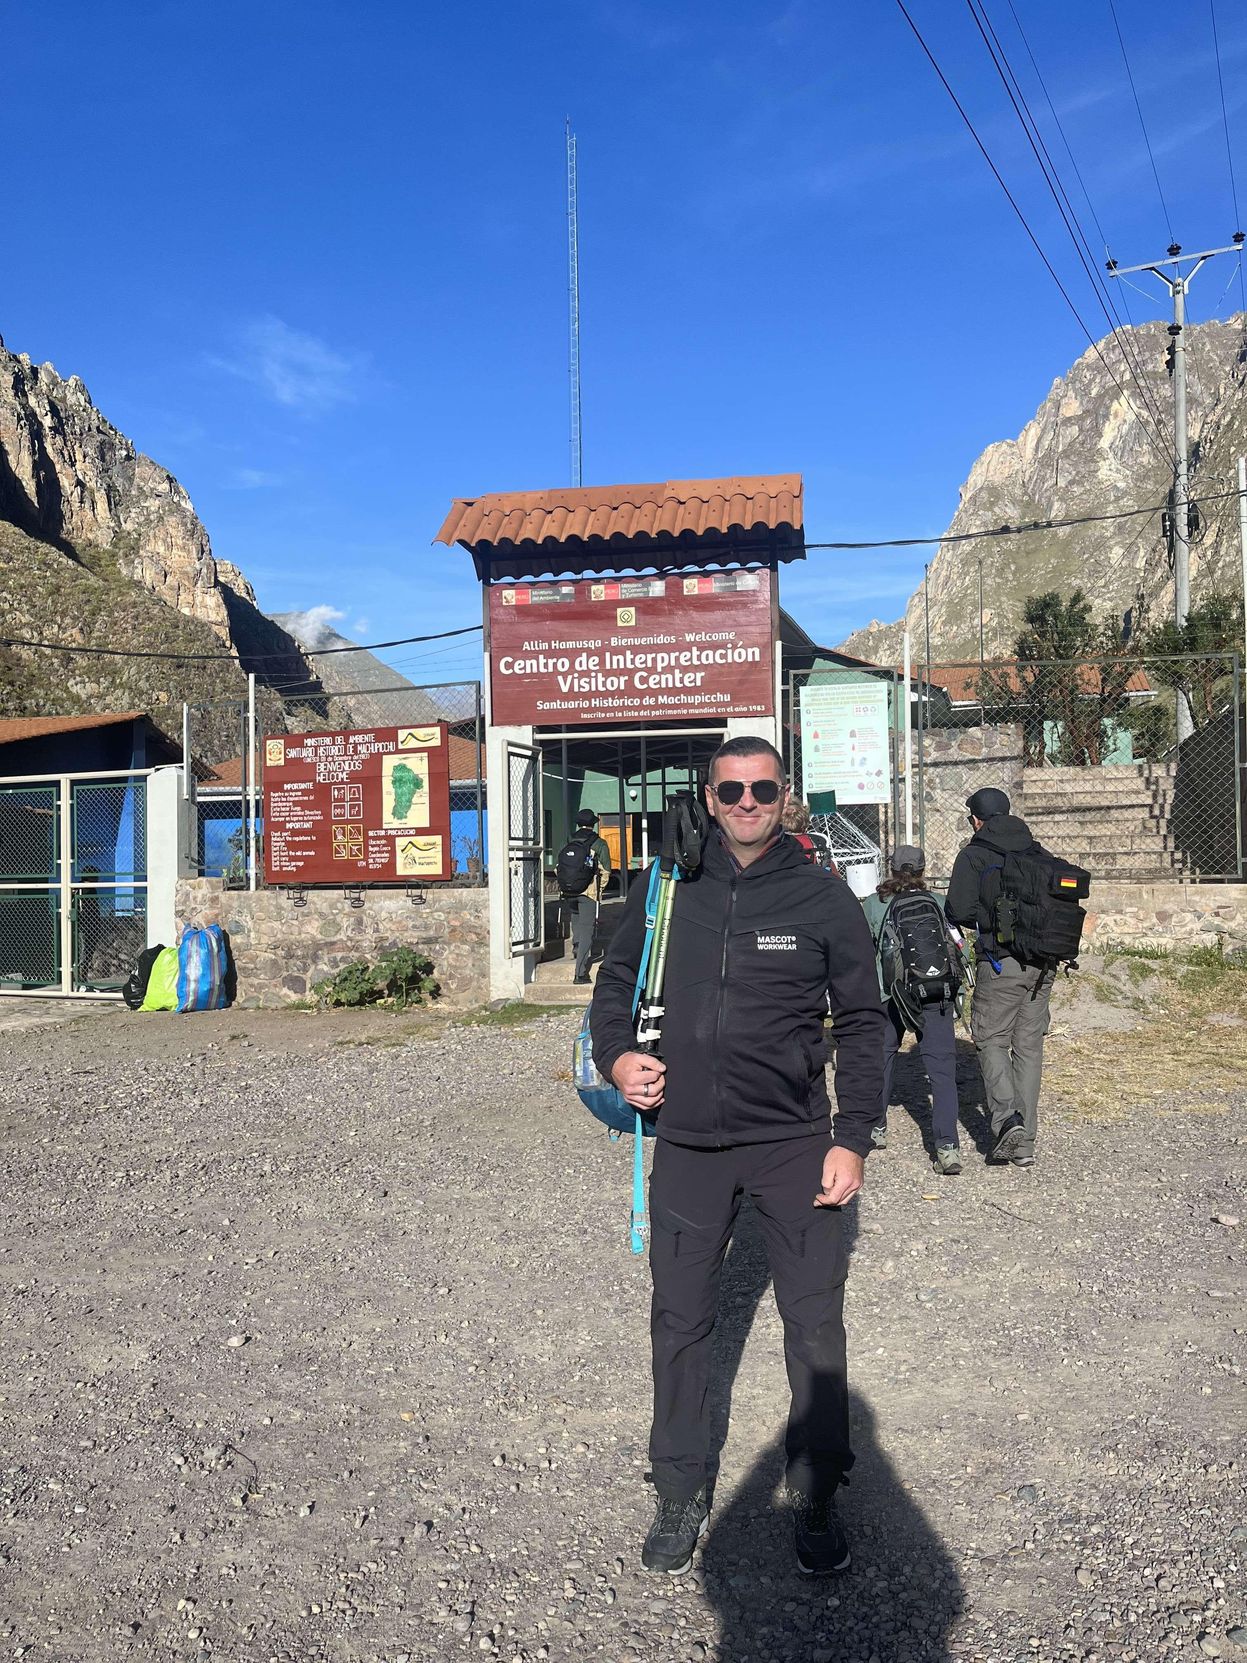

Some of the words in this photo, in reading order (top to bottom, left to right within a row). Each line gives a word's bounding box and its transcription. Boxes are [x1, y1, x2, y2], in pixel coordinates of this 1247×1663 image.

[522, 640, 549, 651] Allin
[551, 639, 602, 650] Hamusqa
[610, 634, 676, 647] Bienvenidos
[685, 631, 736, 642] Welcome
[499, 654, 570, 674] Centro
[574, 652, 599, 671] de
[605, 641, 760, 672] Interpretación
[557, 672, 628, 693] Visitor
[634, 669, 705, 689] Center
[536, 698, 589, 710] Santuario
[591, 696, 640, 707] Histórico
[642, 695, 656, 706] de
[658, 692, 731, 705] Machupicchu
[651, 707, 687, 717] patrimonio
[688, 706, 716, 714] mundial
[335, 736, 346, 745] DEL
[349, 734, 376, 743] AMBIENTE
[286, 747, 315, 759] SANTUARIO
[347, 744, 354, 754] DE
[316, 760, 363, 772] BIENVENIDOS
[316, 771, 350, 783] WELCOME
